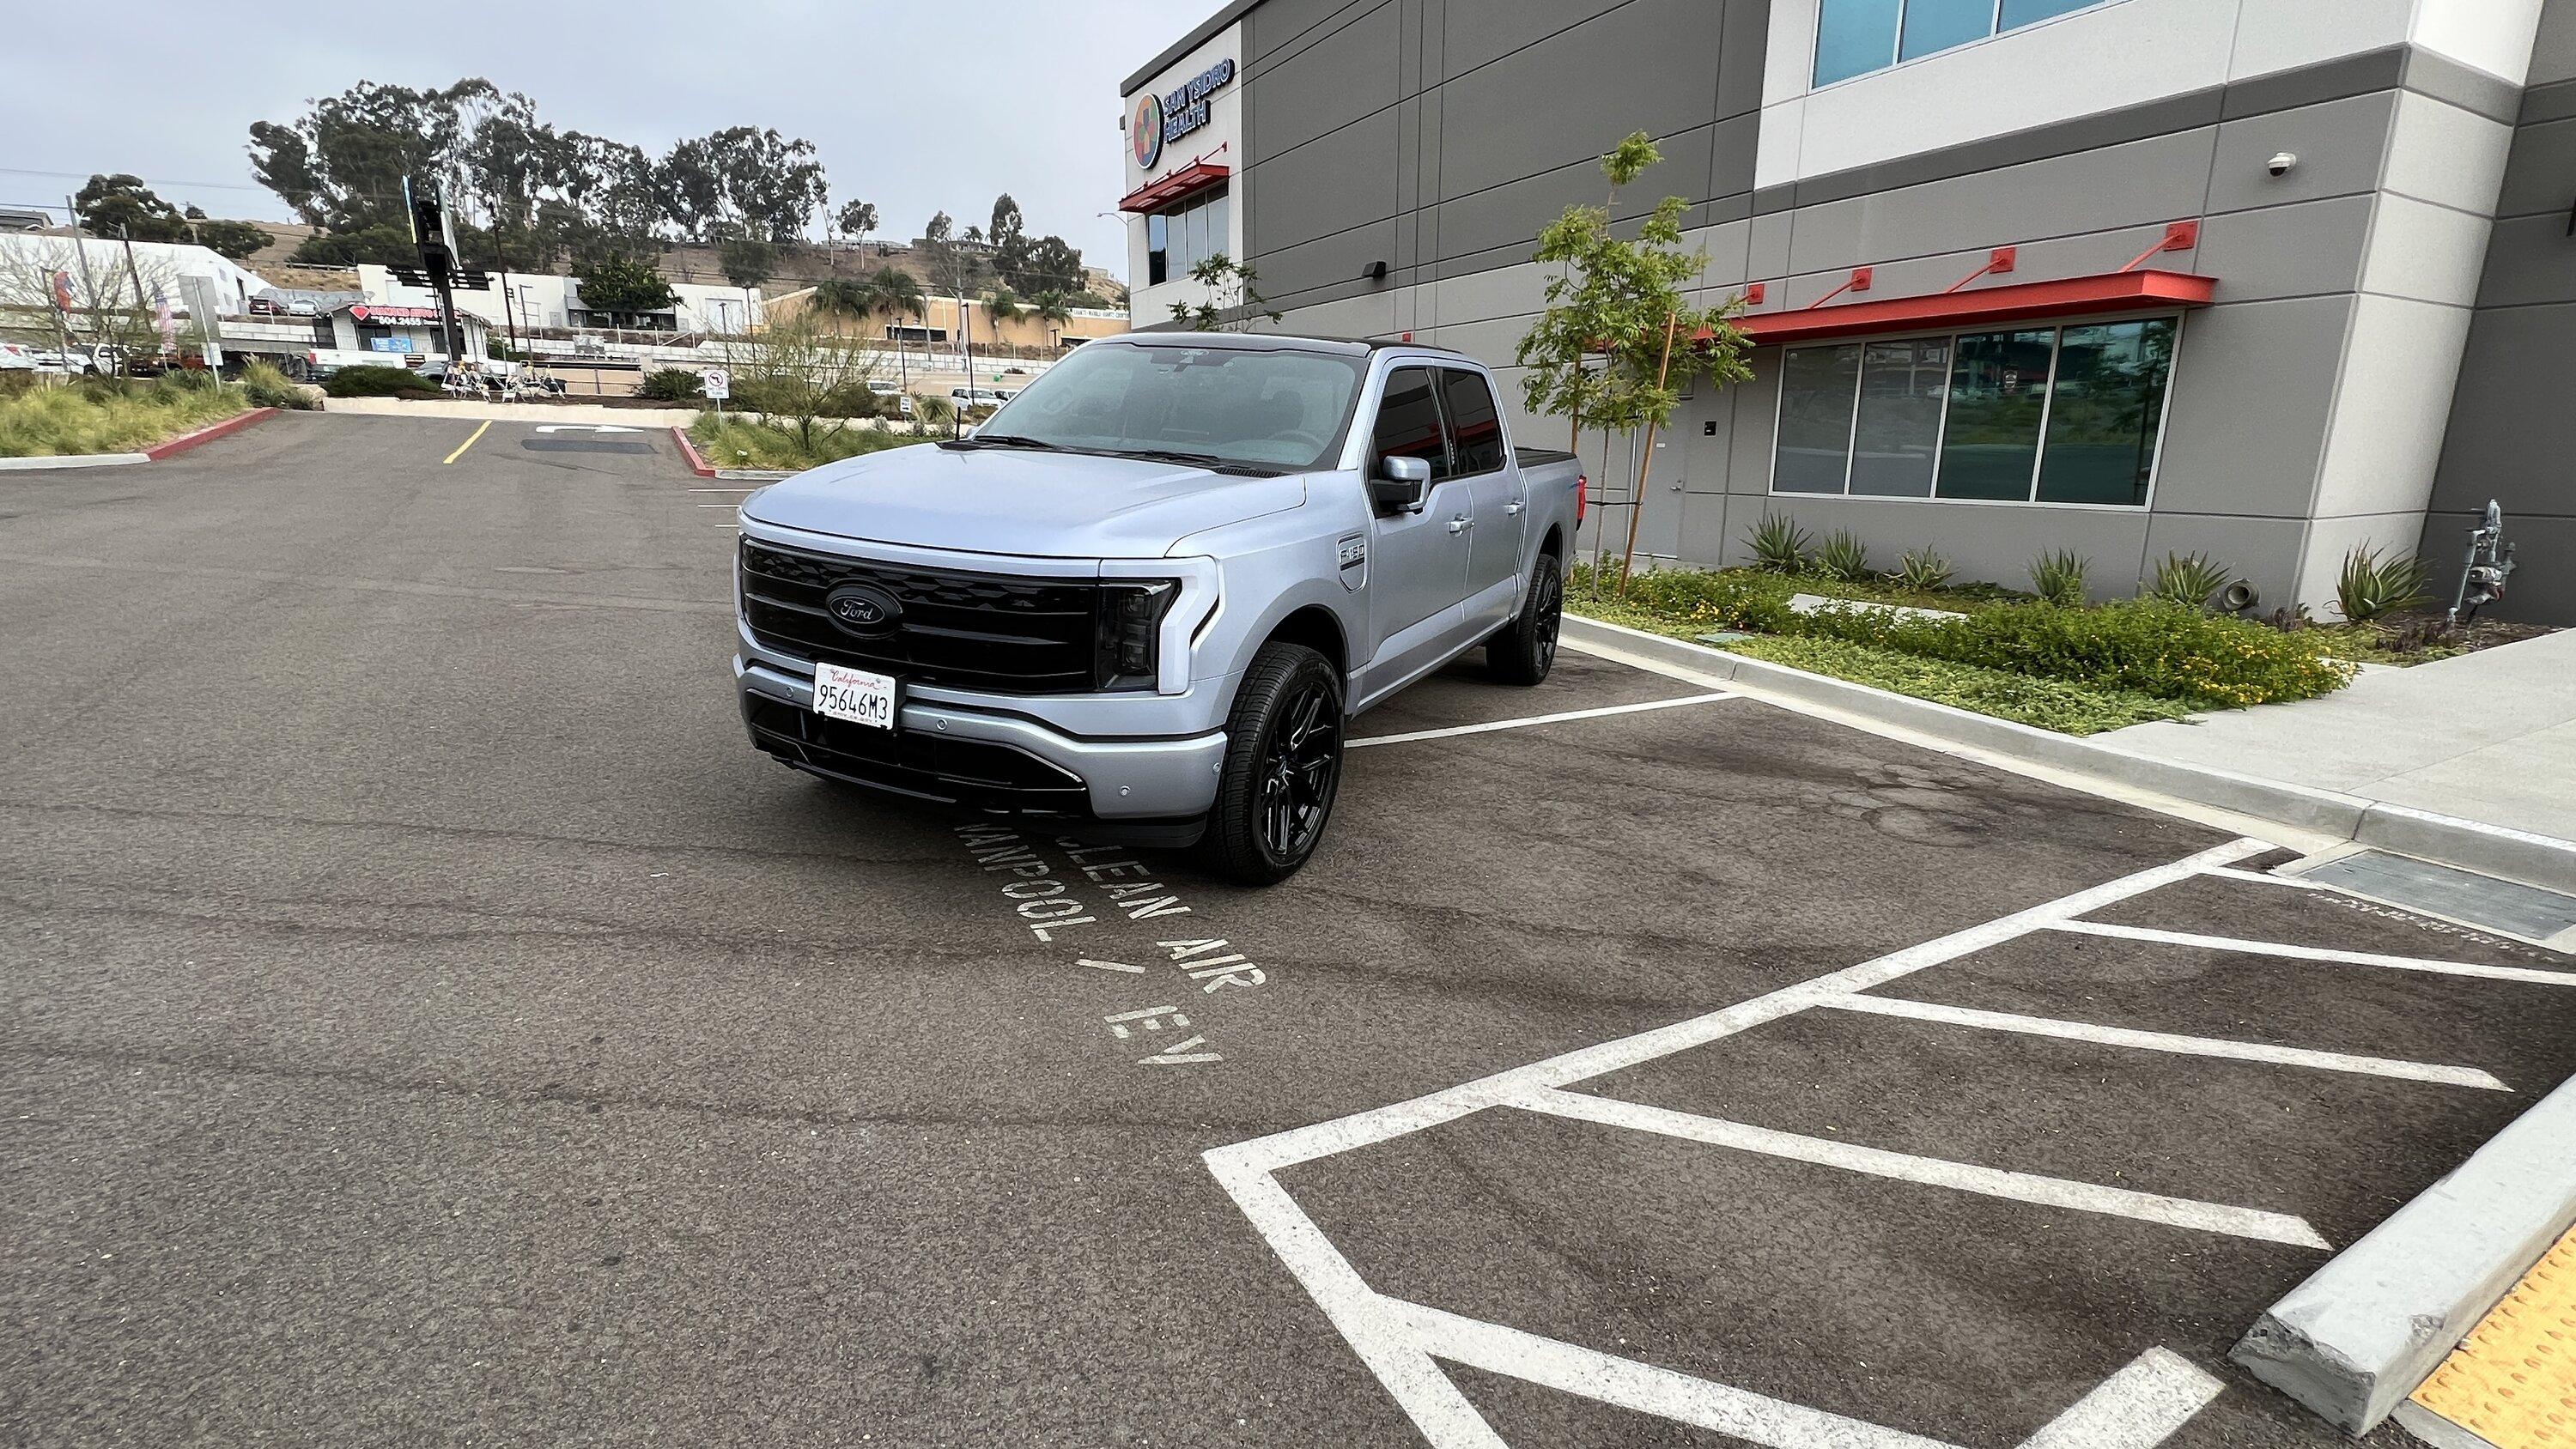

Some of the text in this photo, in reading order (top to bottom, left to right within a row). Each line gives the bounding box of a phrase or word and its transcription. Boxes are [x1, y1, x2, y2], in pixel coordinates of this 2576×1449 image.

[1163, 58, 1232, 116] SAN YSIDRO
[1163, 100, 1208, 143] HEALTH
[369, 306, 410, 318] DIAMOND
[410, 309, 434, 318] AUTO
[1339, 543, 1365, 564] F-150
[840, 599, 874, 620] Ford
[831, 670, 881, 690] California
[818, 684, 889, 720] 95646M3
[954, 822, 1097, 942] VANPOOL
[1103, 1004, 1224, 1065] EV
[1156, 938, 1267, 994] AIR
